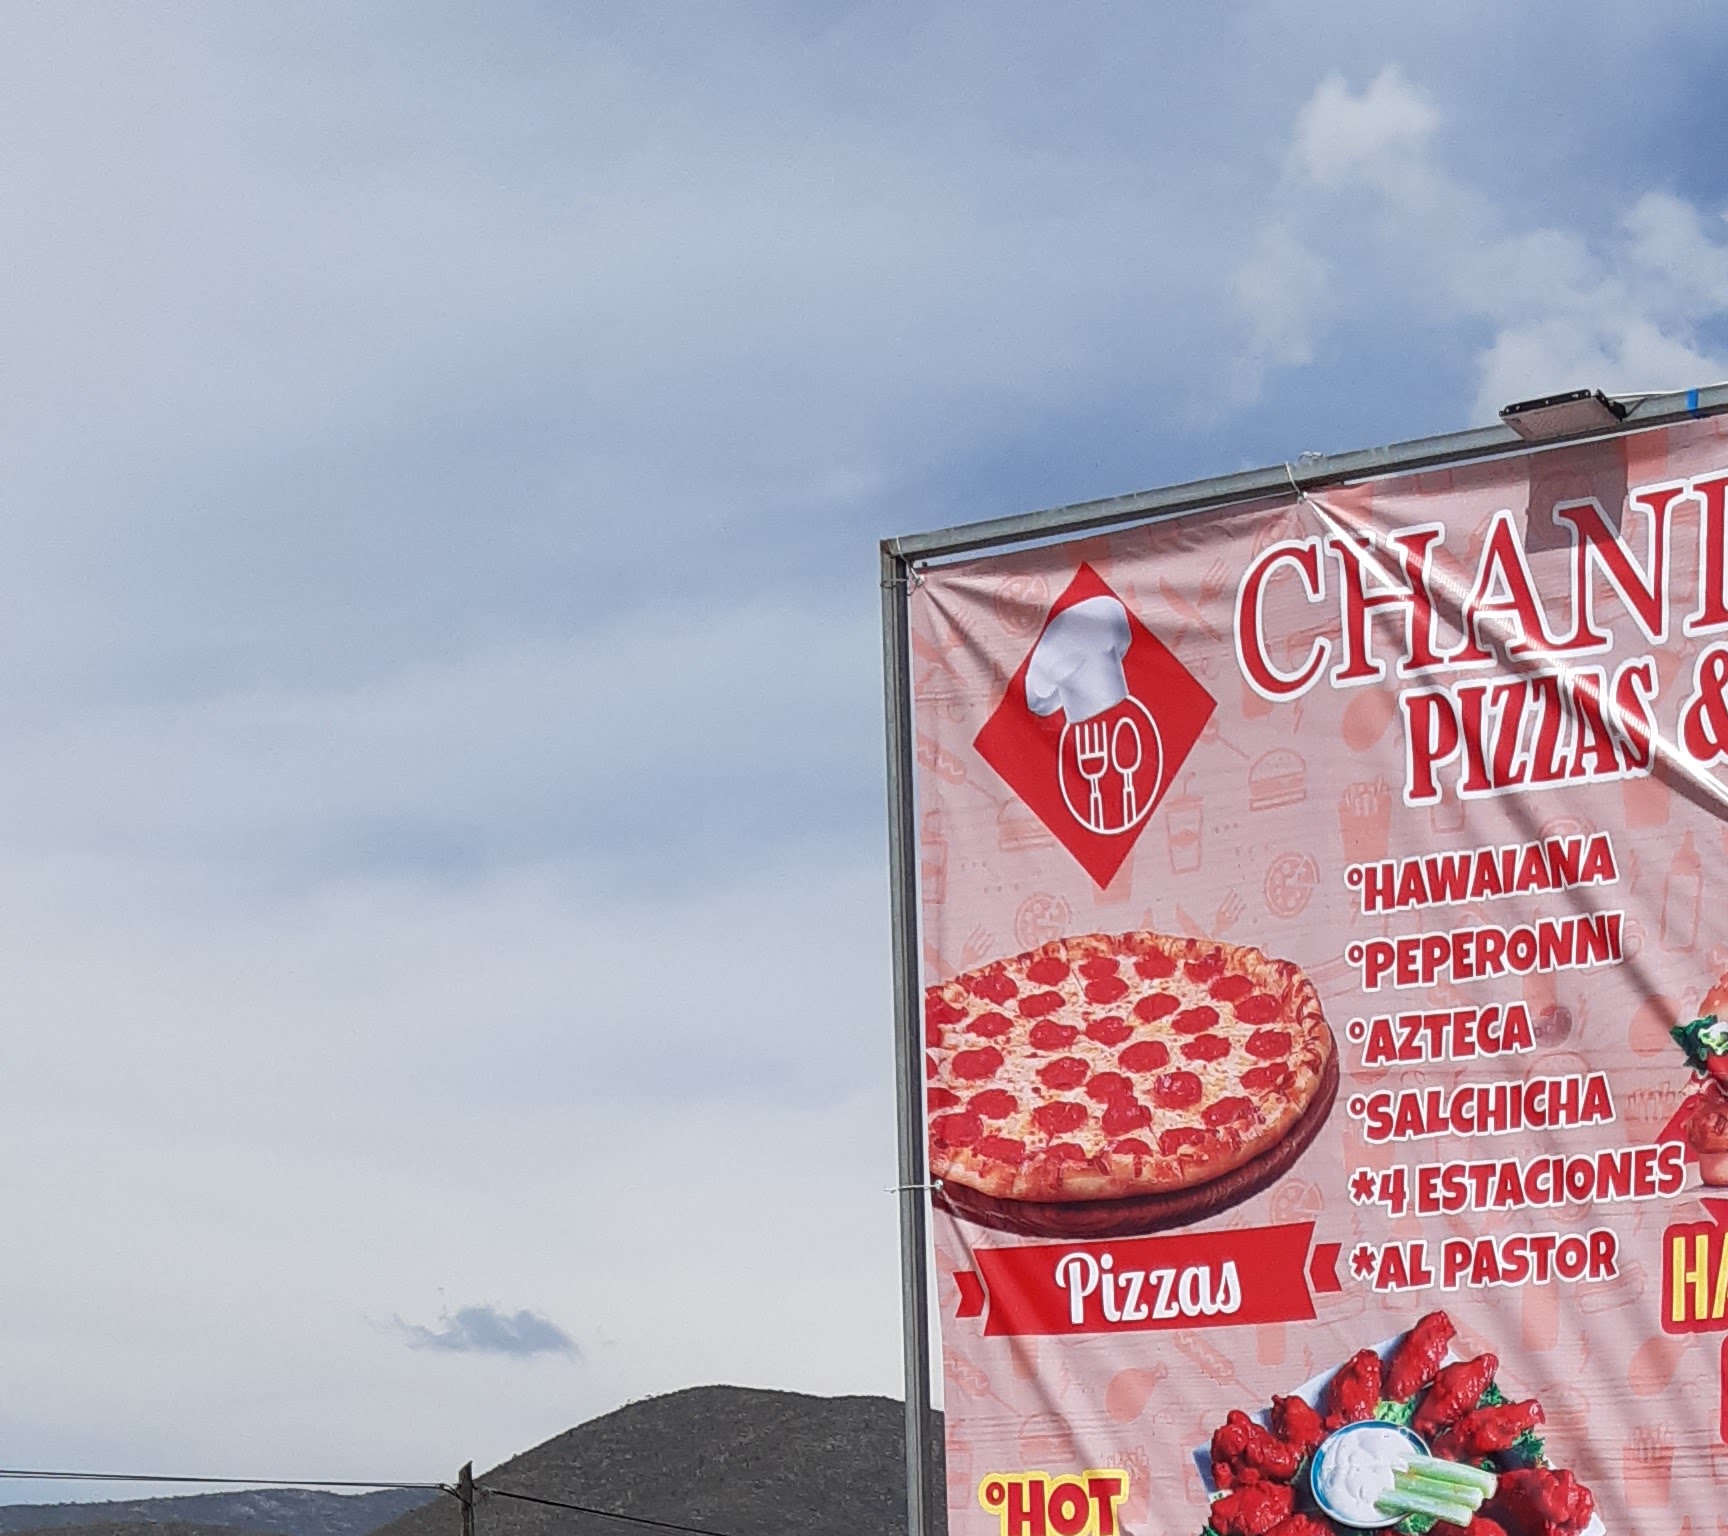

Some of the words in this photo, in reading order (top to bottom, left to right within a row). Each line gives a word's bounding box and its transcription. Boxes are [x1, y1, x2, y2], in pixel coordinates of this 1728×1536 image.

[1405, 656, 1658, 806] PIZZAS
[1415, 1141, 1686, 1215] ESTACIONES
[1055, 1252, 1242, 1325] Pizzas
[1441, 1227, 1619, 1290] PASTOR
